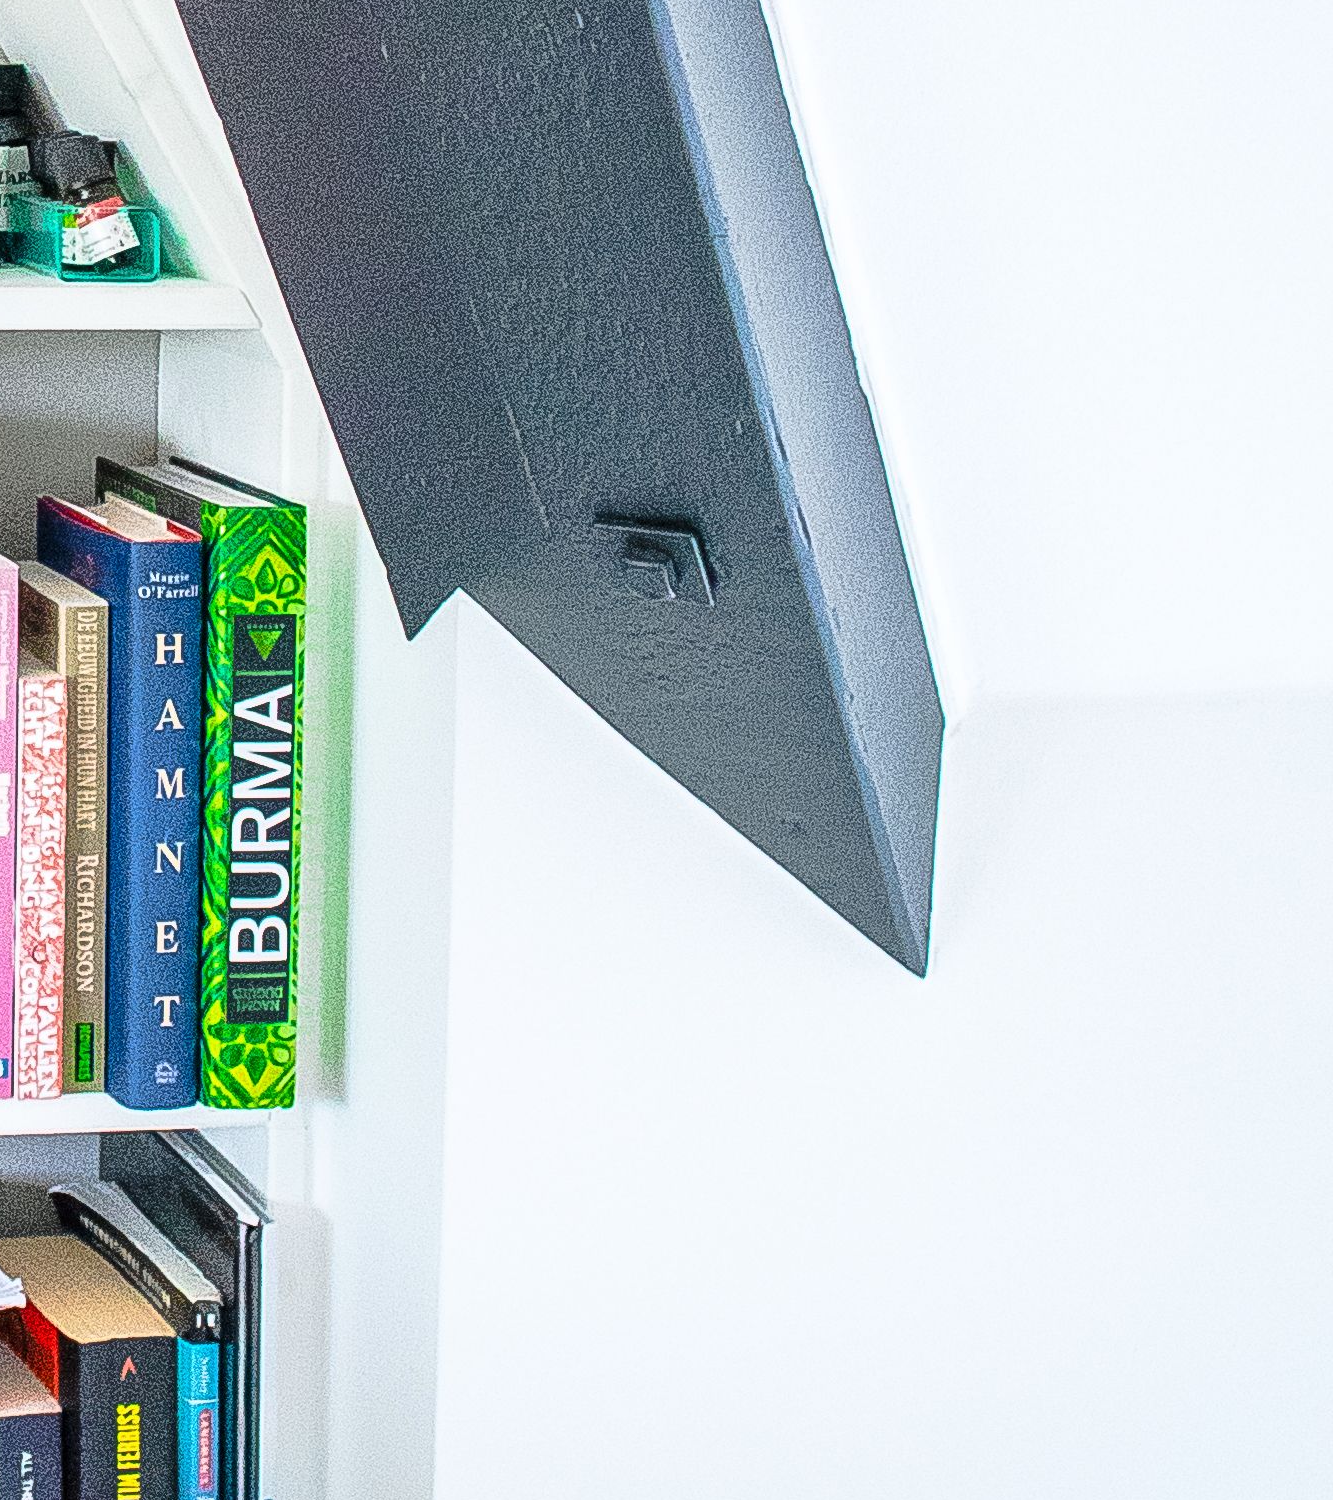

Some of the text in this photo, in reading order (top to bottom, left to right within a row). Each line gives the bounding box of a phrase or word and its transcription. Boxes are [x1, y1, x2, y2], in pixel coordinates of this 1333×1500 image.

[138, 583, 200, 600] O'Farrell
[229, 683, 294, 964] BURMA
[75, 853, 100, 993] RICHARDSON
[20, 1451, 34, 1477] ALL
[116, 1403, 141, 1470] FERRISS
